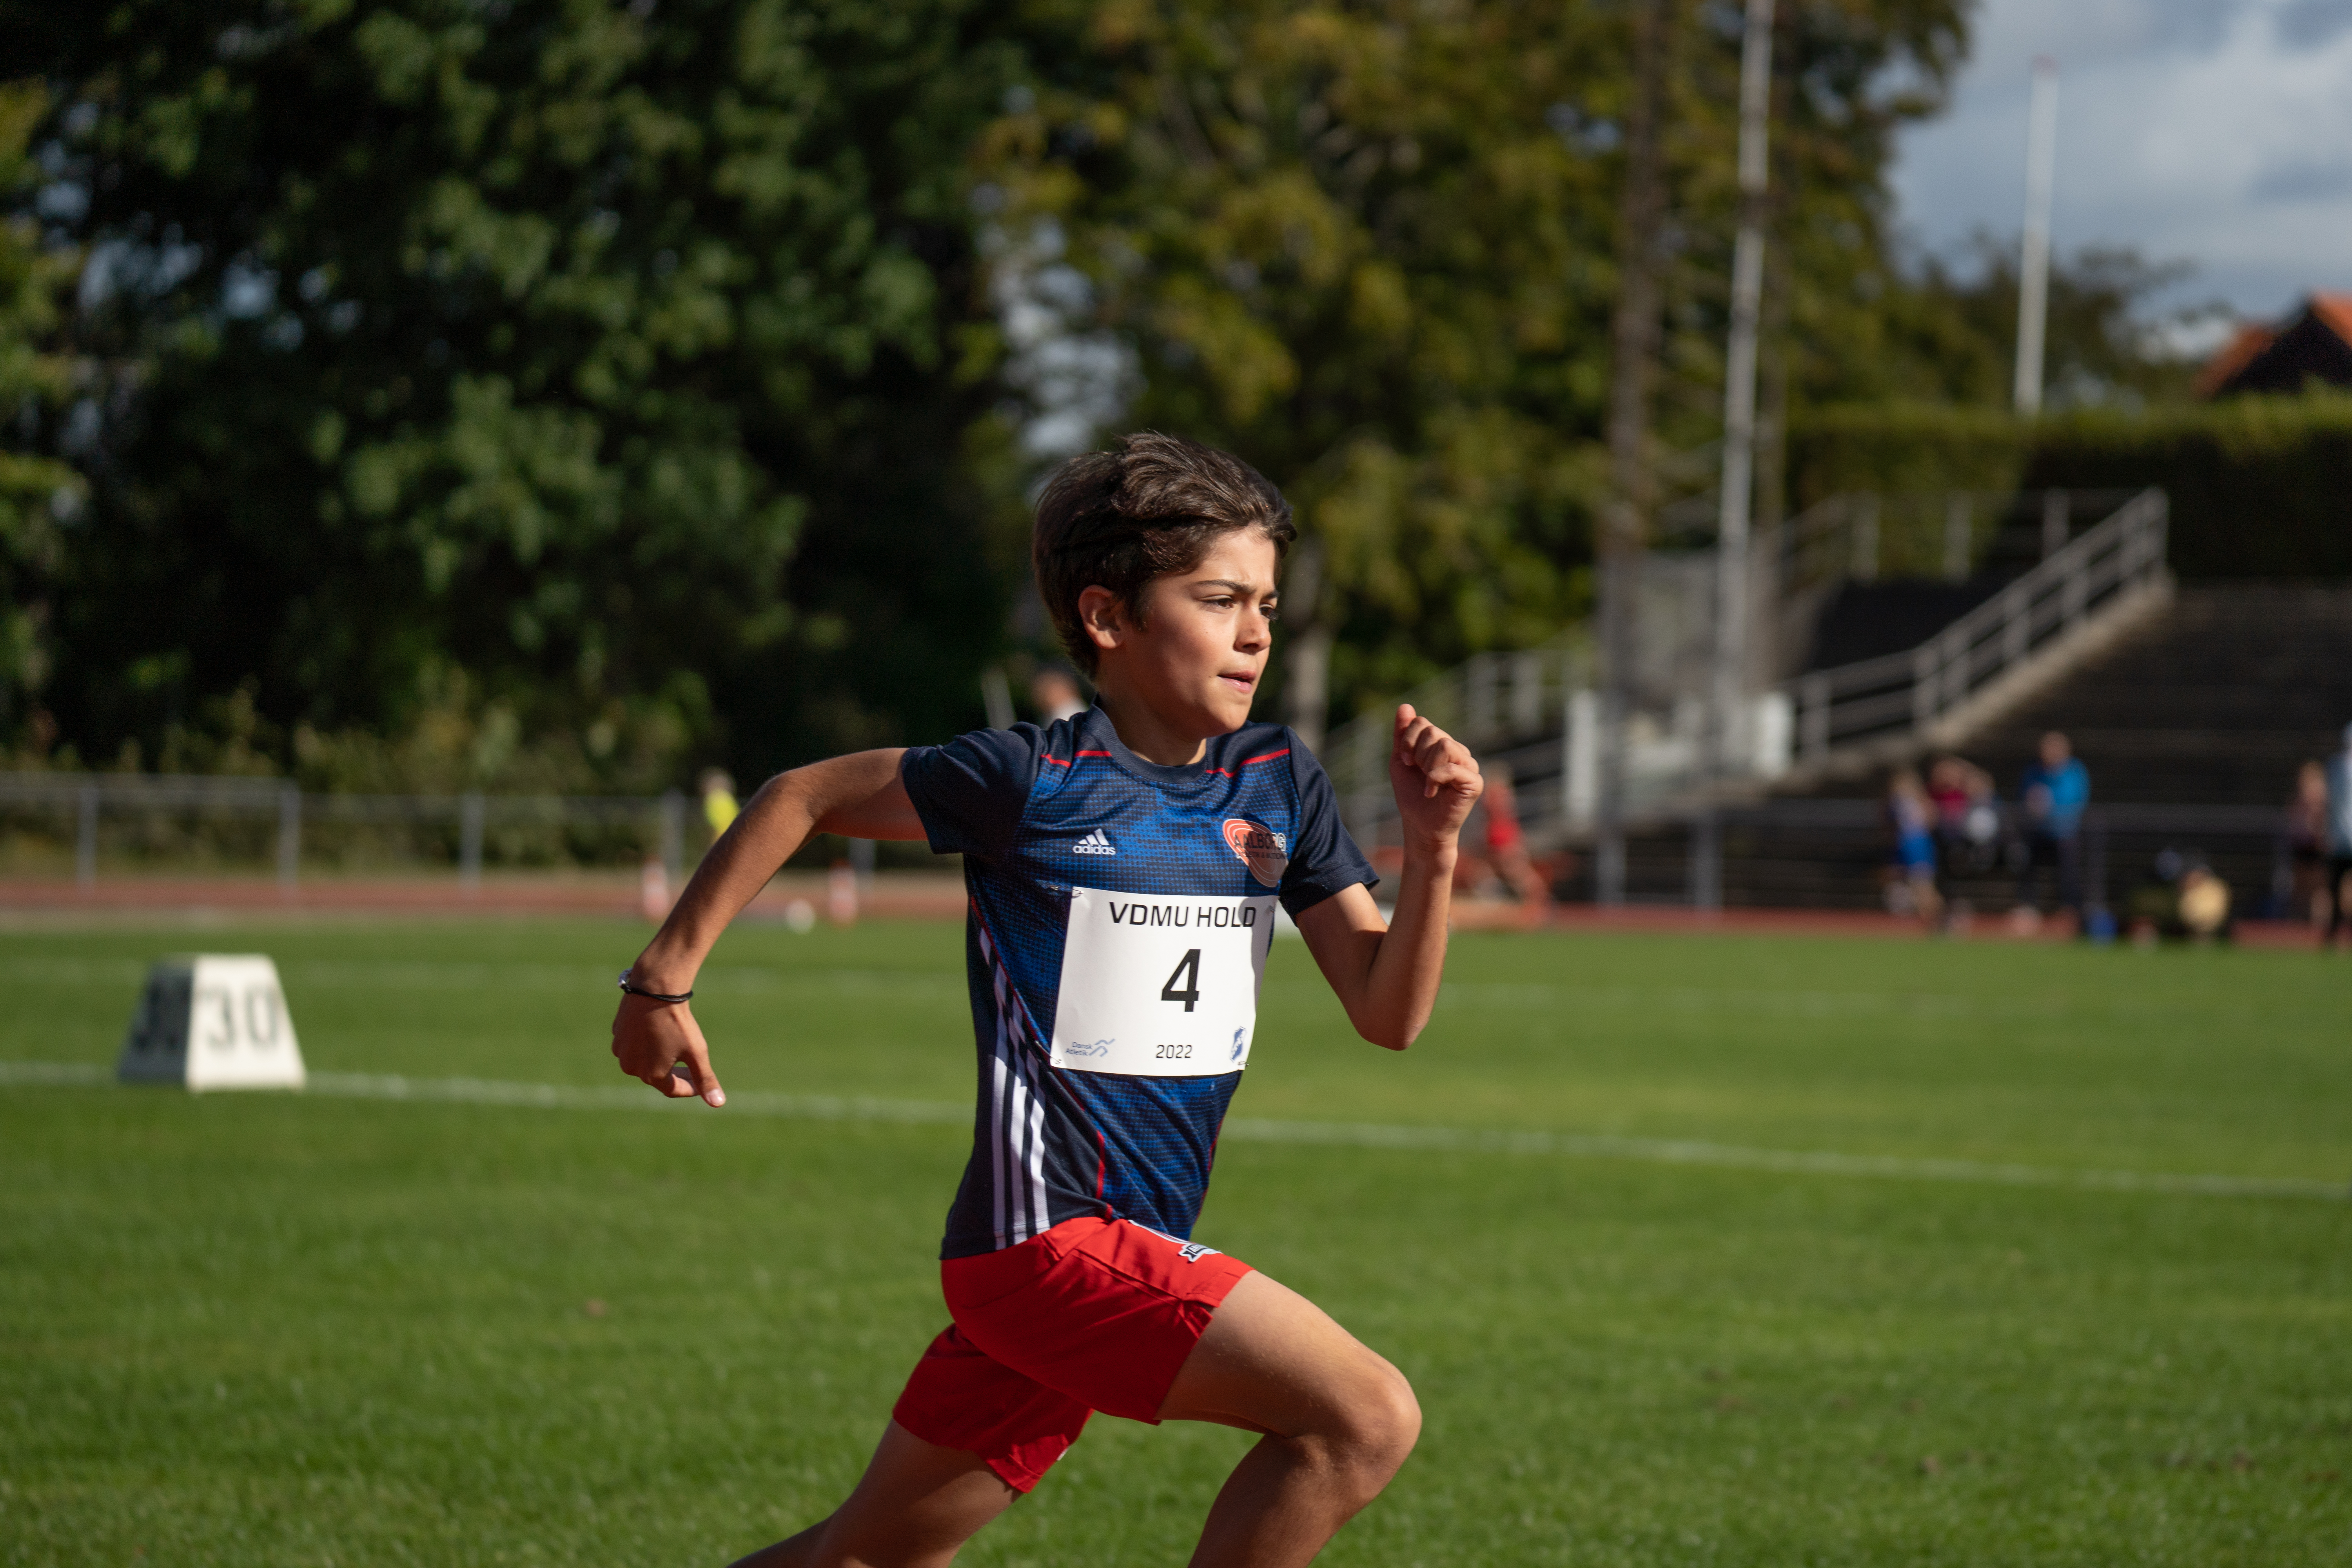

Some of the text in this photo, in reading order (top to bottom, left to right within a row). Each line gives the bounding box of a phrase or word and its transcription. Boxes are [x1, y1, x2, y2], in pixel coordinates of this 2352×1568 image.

[1072, 844, 1116, 855] adidas
[1234, 833, 1287, 851] AALBORG
[1109, 901, 1256, 927] VDMU HOLD
[1161, 949, 1201, 1012] 4
[194, 985, 279, 1051] 30
[1072, 1042, 1093, 1050] Dansk
[1156, 1044, 1192, 1059] 2022
